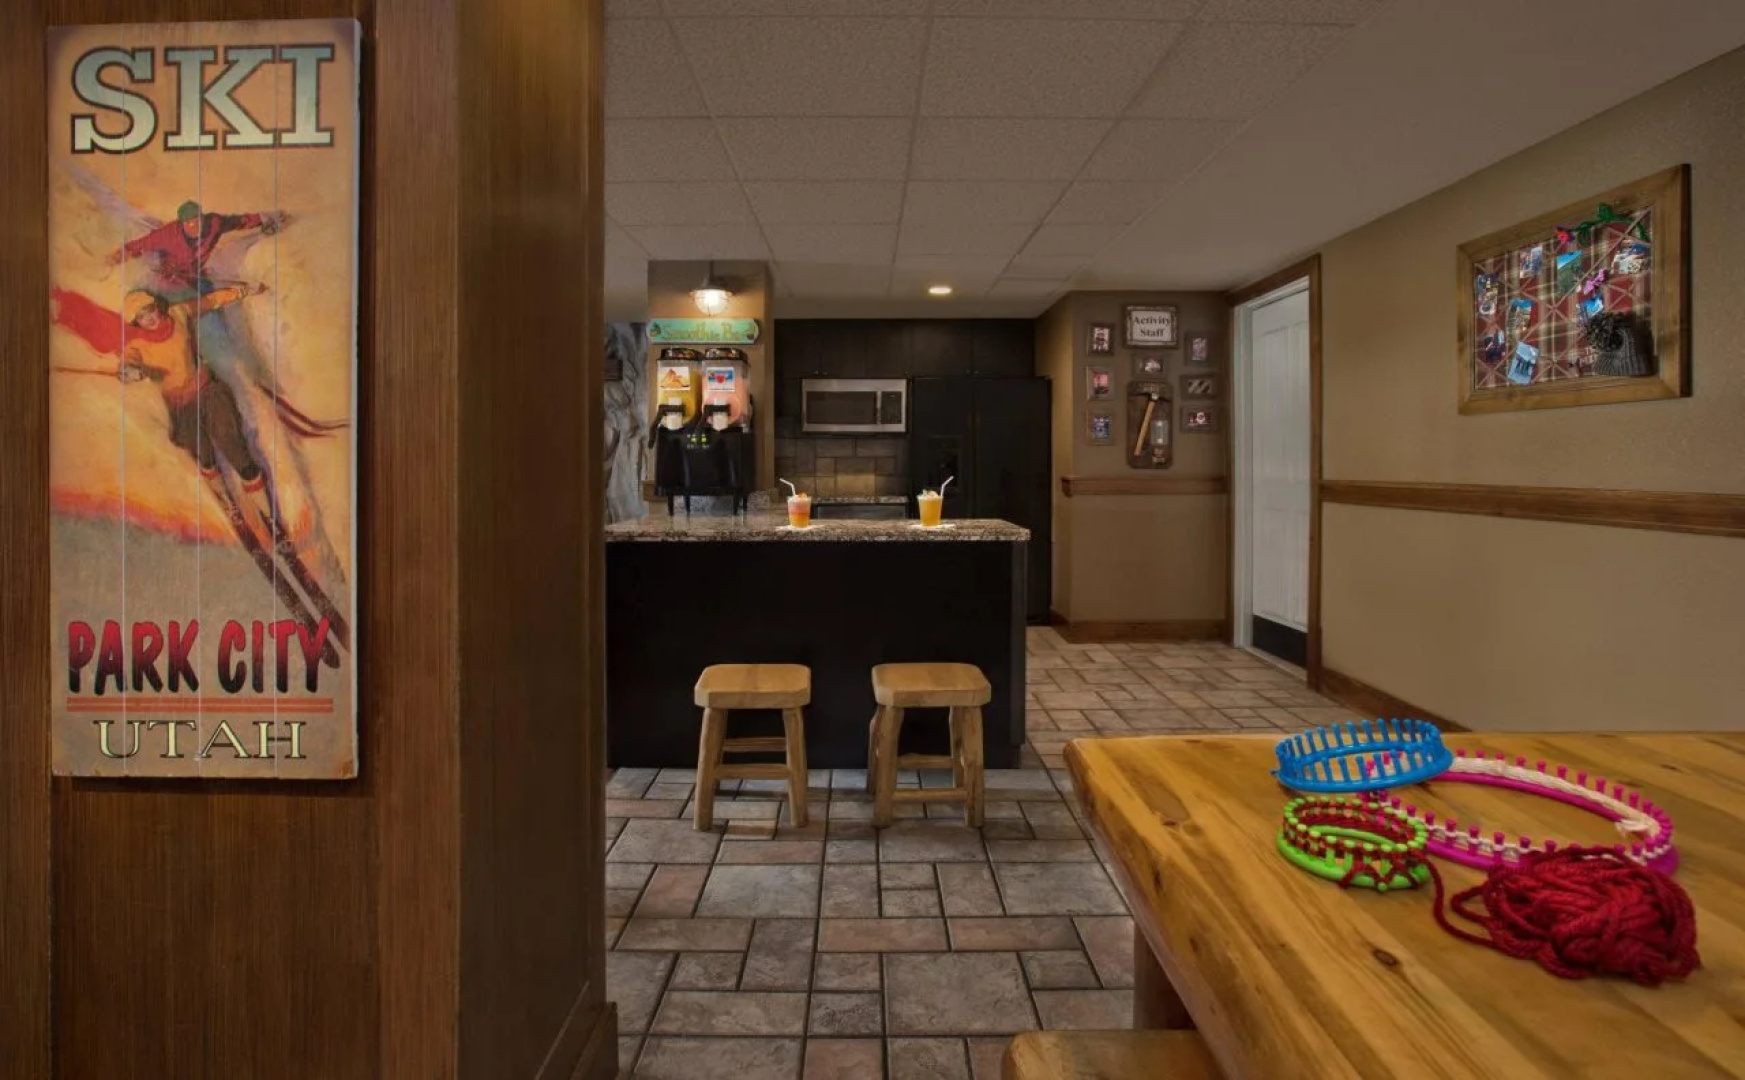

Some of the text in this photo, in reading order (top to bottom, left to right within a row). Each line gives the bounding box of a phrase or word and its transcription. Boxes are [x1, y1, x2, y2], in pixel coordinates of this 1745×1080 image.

[71, 43, 335, 154] SKI
[660, 321, 720, 341] Smoothie
[1133, 316, 1169, 327] Activity
[1140, 328, 1165, 338] Staff
[67, 615, 331, 695] PARK CITY
[93, 719, 306, 759] UTAH
